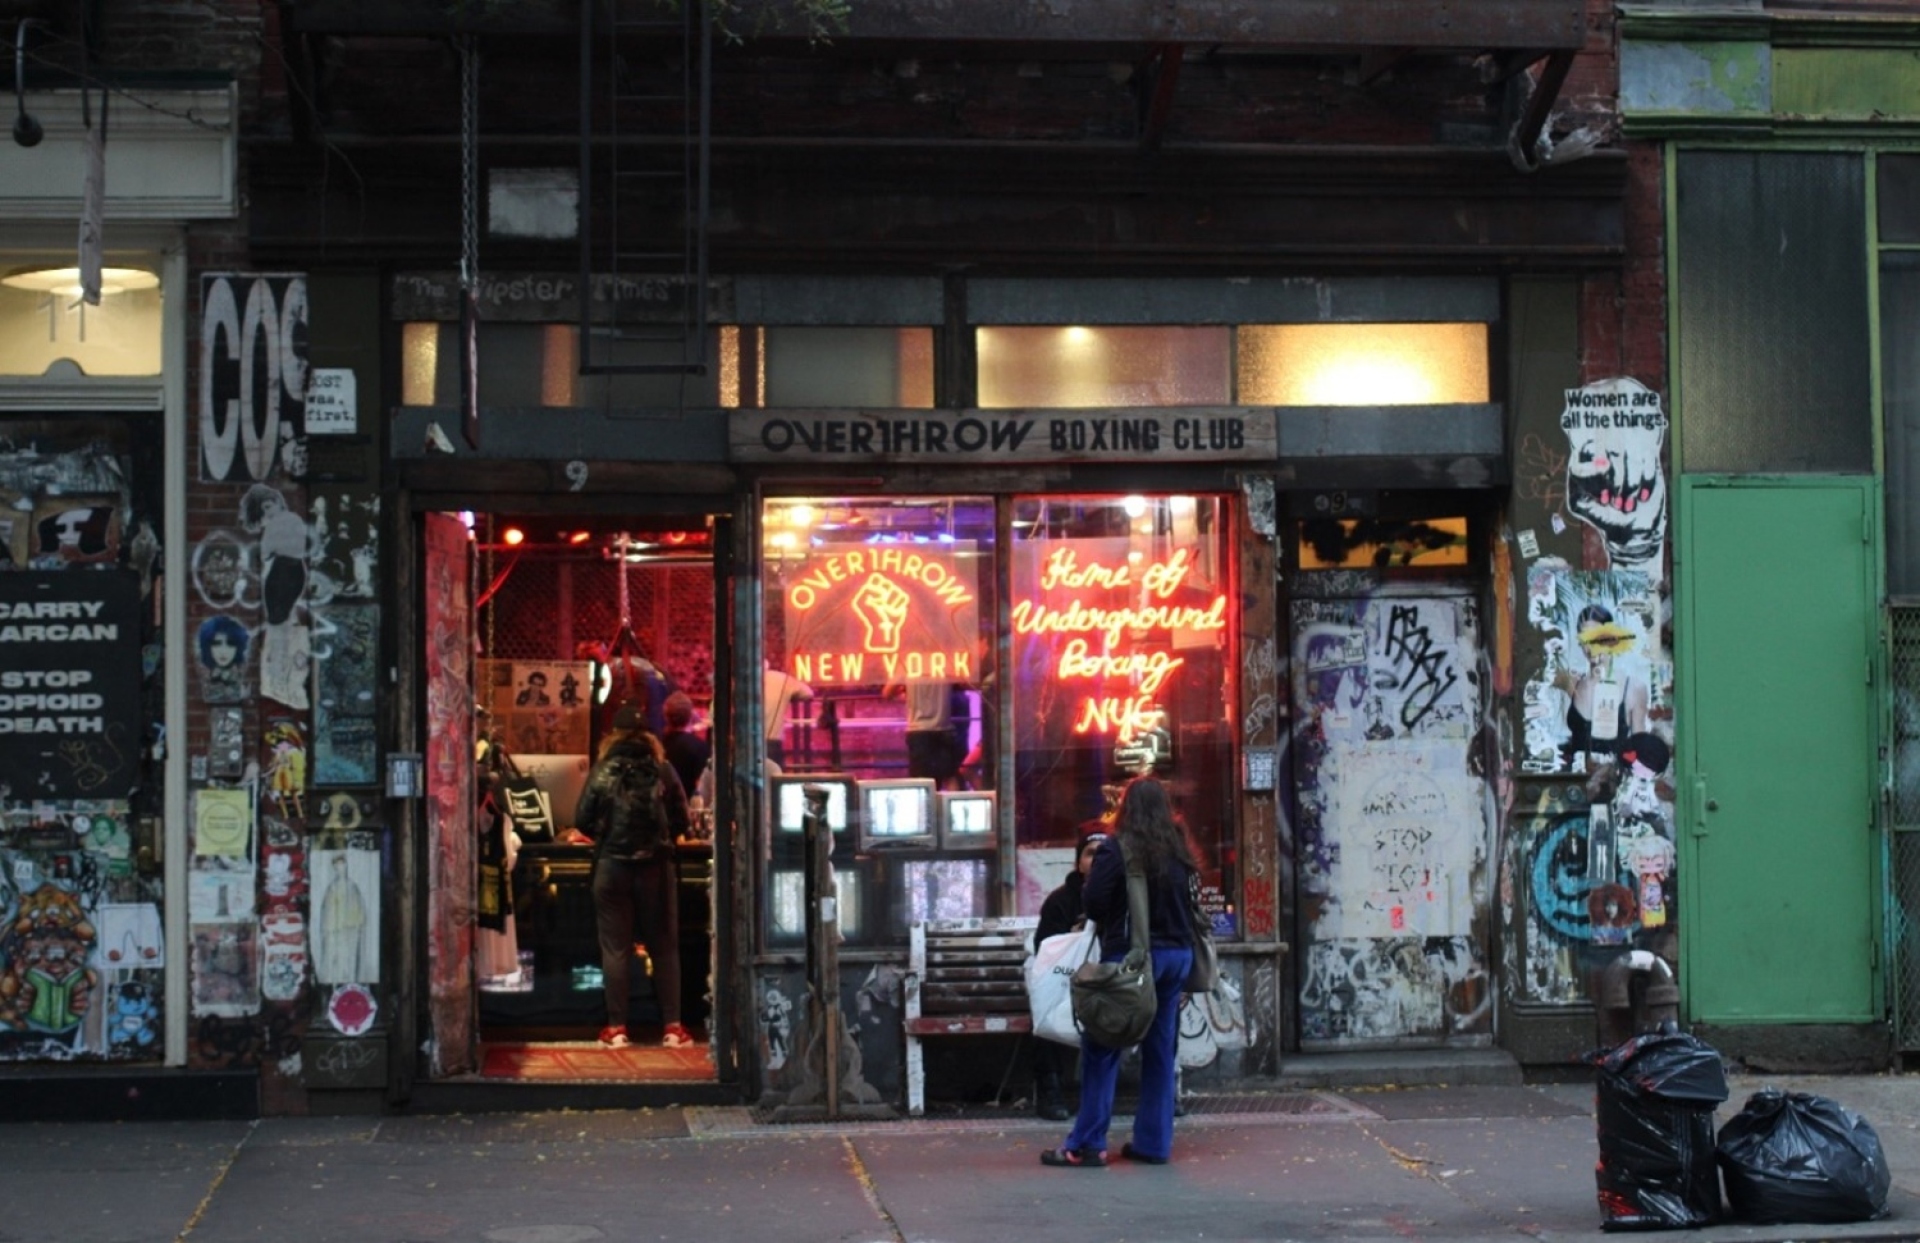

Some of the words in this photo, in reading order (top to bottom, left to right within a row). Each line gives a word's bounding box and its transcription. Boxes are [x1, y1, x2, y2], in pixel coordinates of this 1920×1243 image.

[1567, 391, 1628, 407] Women
[1632, 393, 1657, 407] are
[761, 417, 1035, 453] OVERTHROW
[1050, 418, 1159, 452] BOXING
[1173, 417, 1245, 451] CLUB
[1562, 411, 1581, 429] all
[1583, 411, 1610, 429] the
[1613, 411, 1667, 430] things.
[566, 461, 589, 492] 9
[790, 548, 973, 609] OVERTHROW
[1042, 546, 1131, 590] Home
[1141, 547, 1189, 598] of
[1012, 594, 1226, 648] Underground
[1, 671, 92, 687] STOP
[795, 652, 863, 682] NEW
[883, 650, 972, 682] YORK
[1058, 638, 1184, 692] Boxing
[0, 694, 104, 711] OPIOID
[0, 717, 104, 733] DEATH
